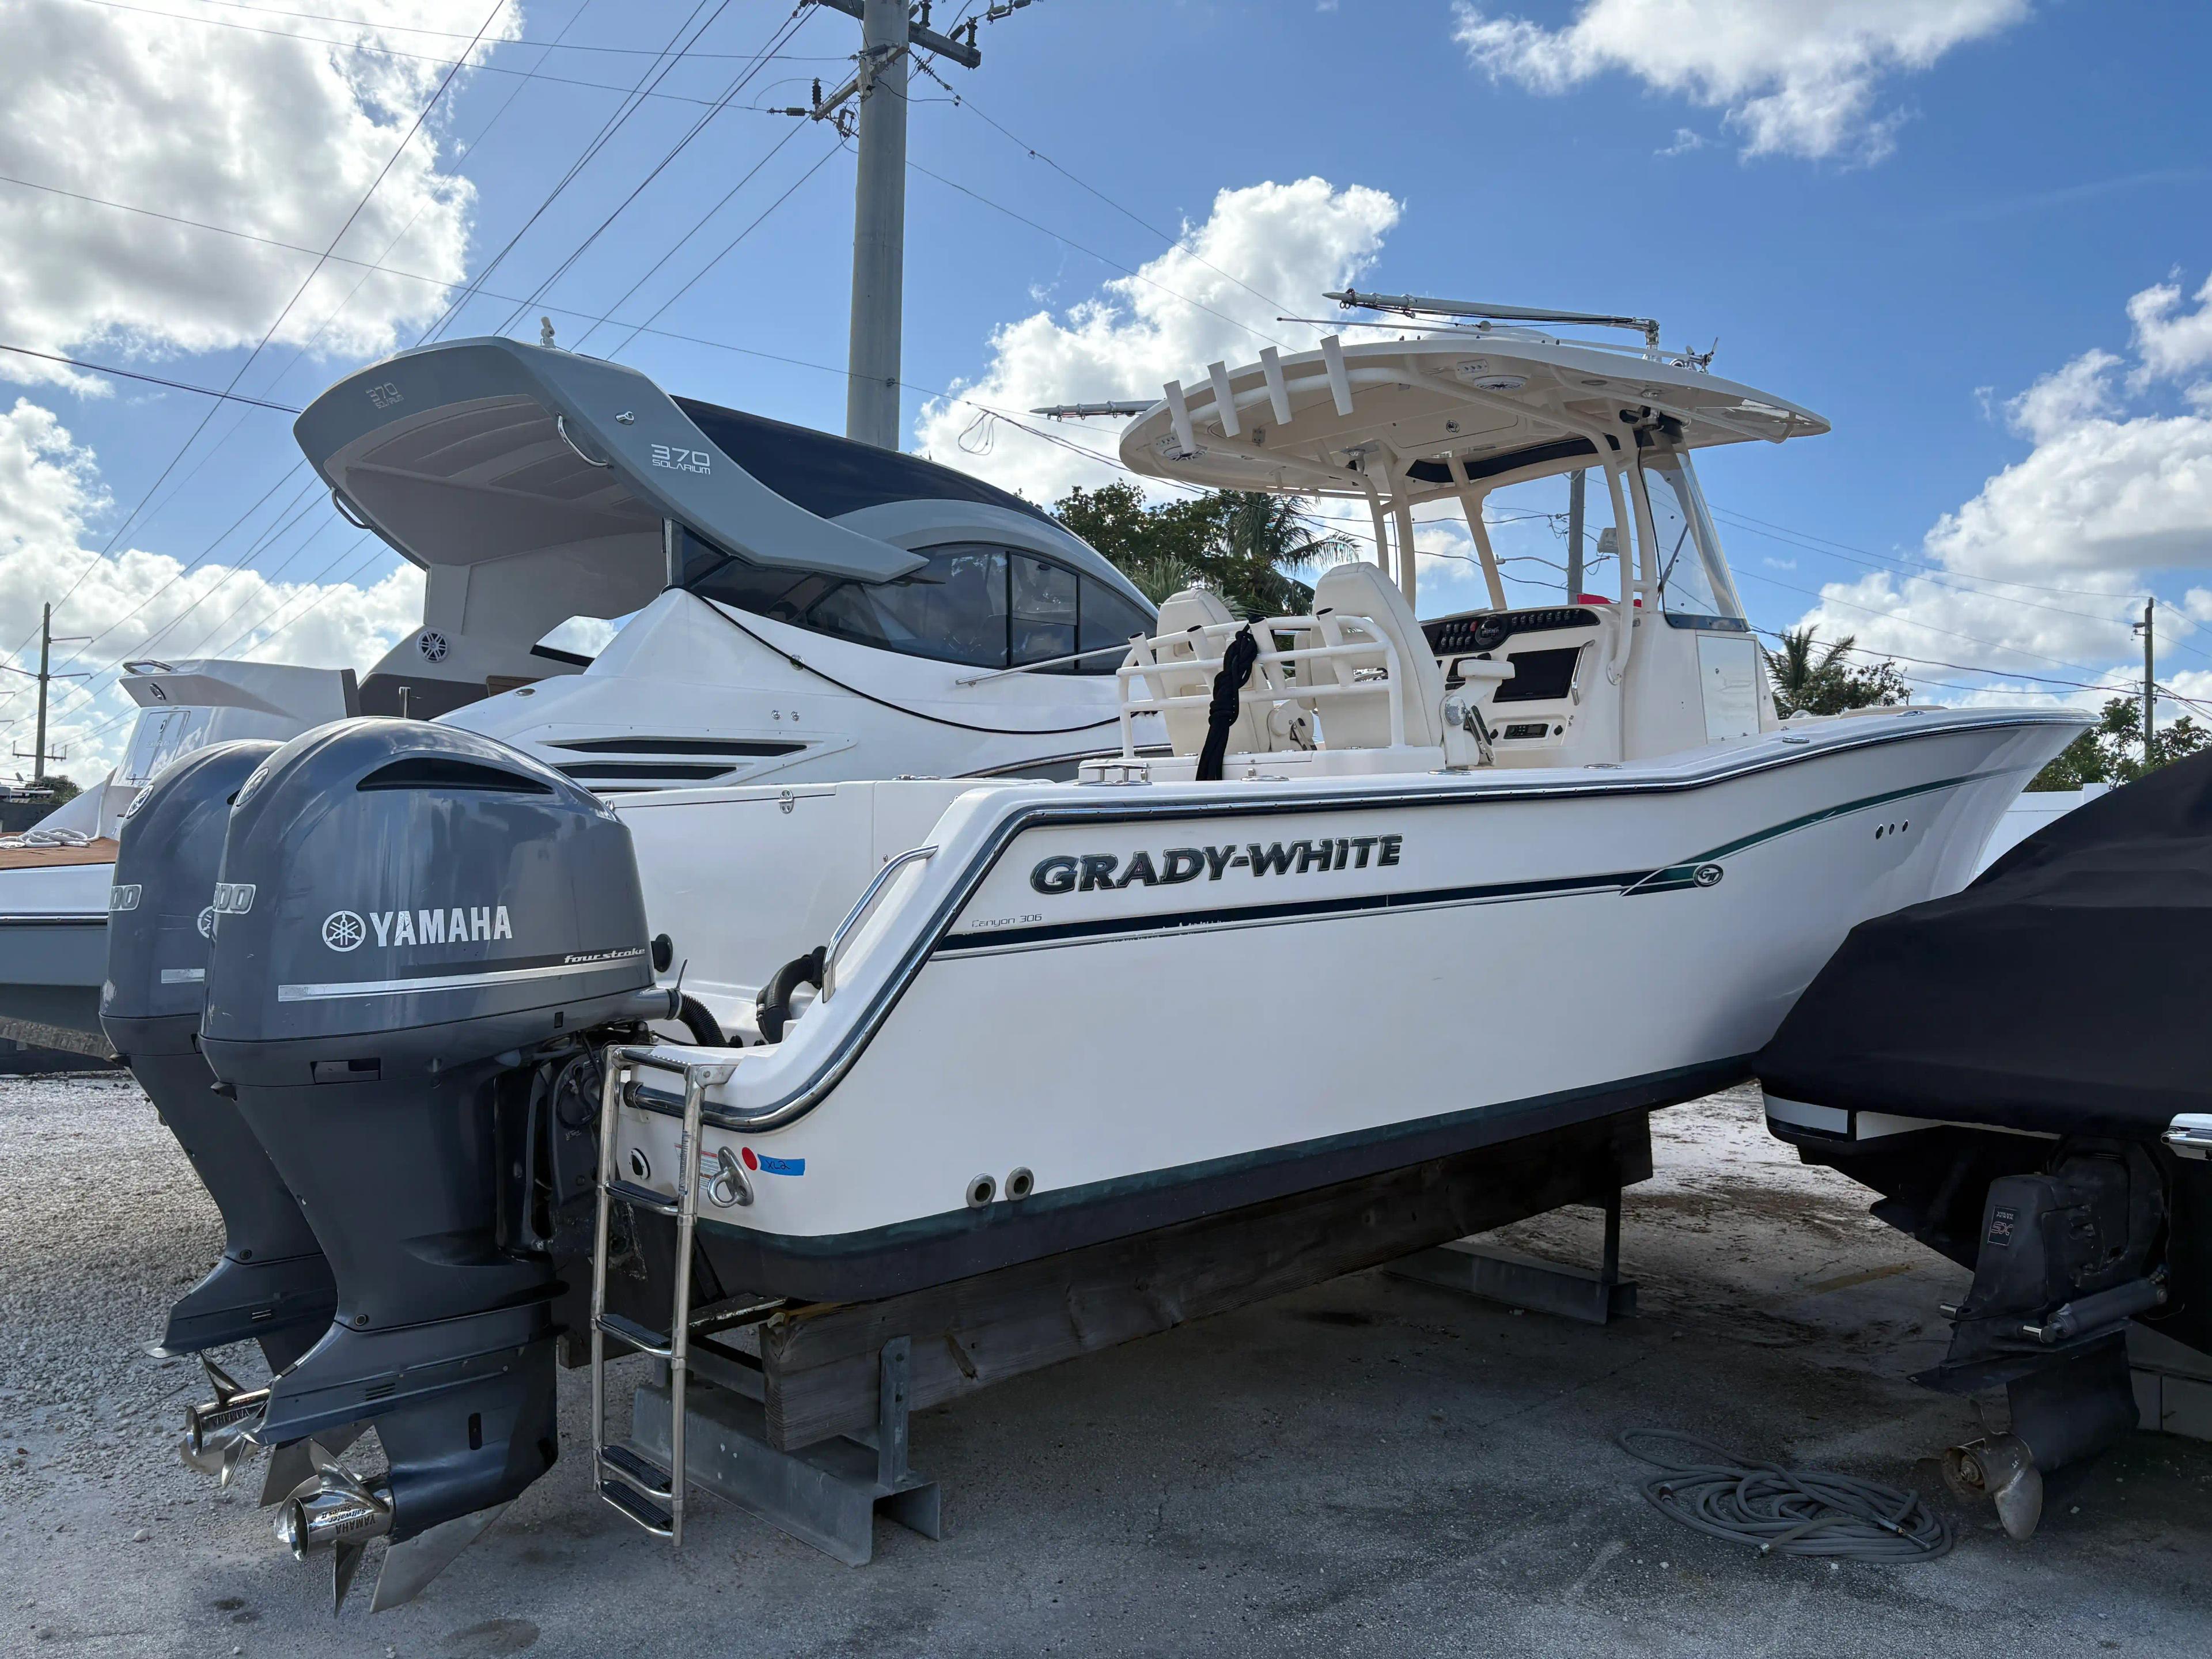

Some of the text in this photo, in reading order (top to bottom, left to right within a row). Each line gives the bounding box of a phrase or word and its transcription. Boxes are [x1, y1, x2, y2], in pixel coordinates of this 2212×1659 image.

[366, 381, 399, 402] 370
[651, 444, 710, 467] 370
[652, 459, 711, 475] SOLARIUM
[1029, 833, 1404, 895] GRADY-WHITE
[369, 905, 513, 948] YAMAHA
[972, 914, 1042, 927] Canyon 306
[765, 1160, 791, 1170] XL2
[1990, 1221, 2014, 1236] SX
[328, 1505, 352, 1517] Series
[328, 1508, 367, 1524] Saltwater
[335, 1514, 376, 1535] YAMAHA
